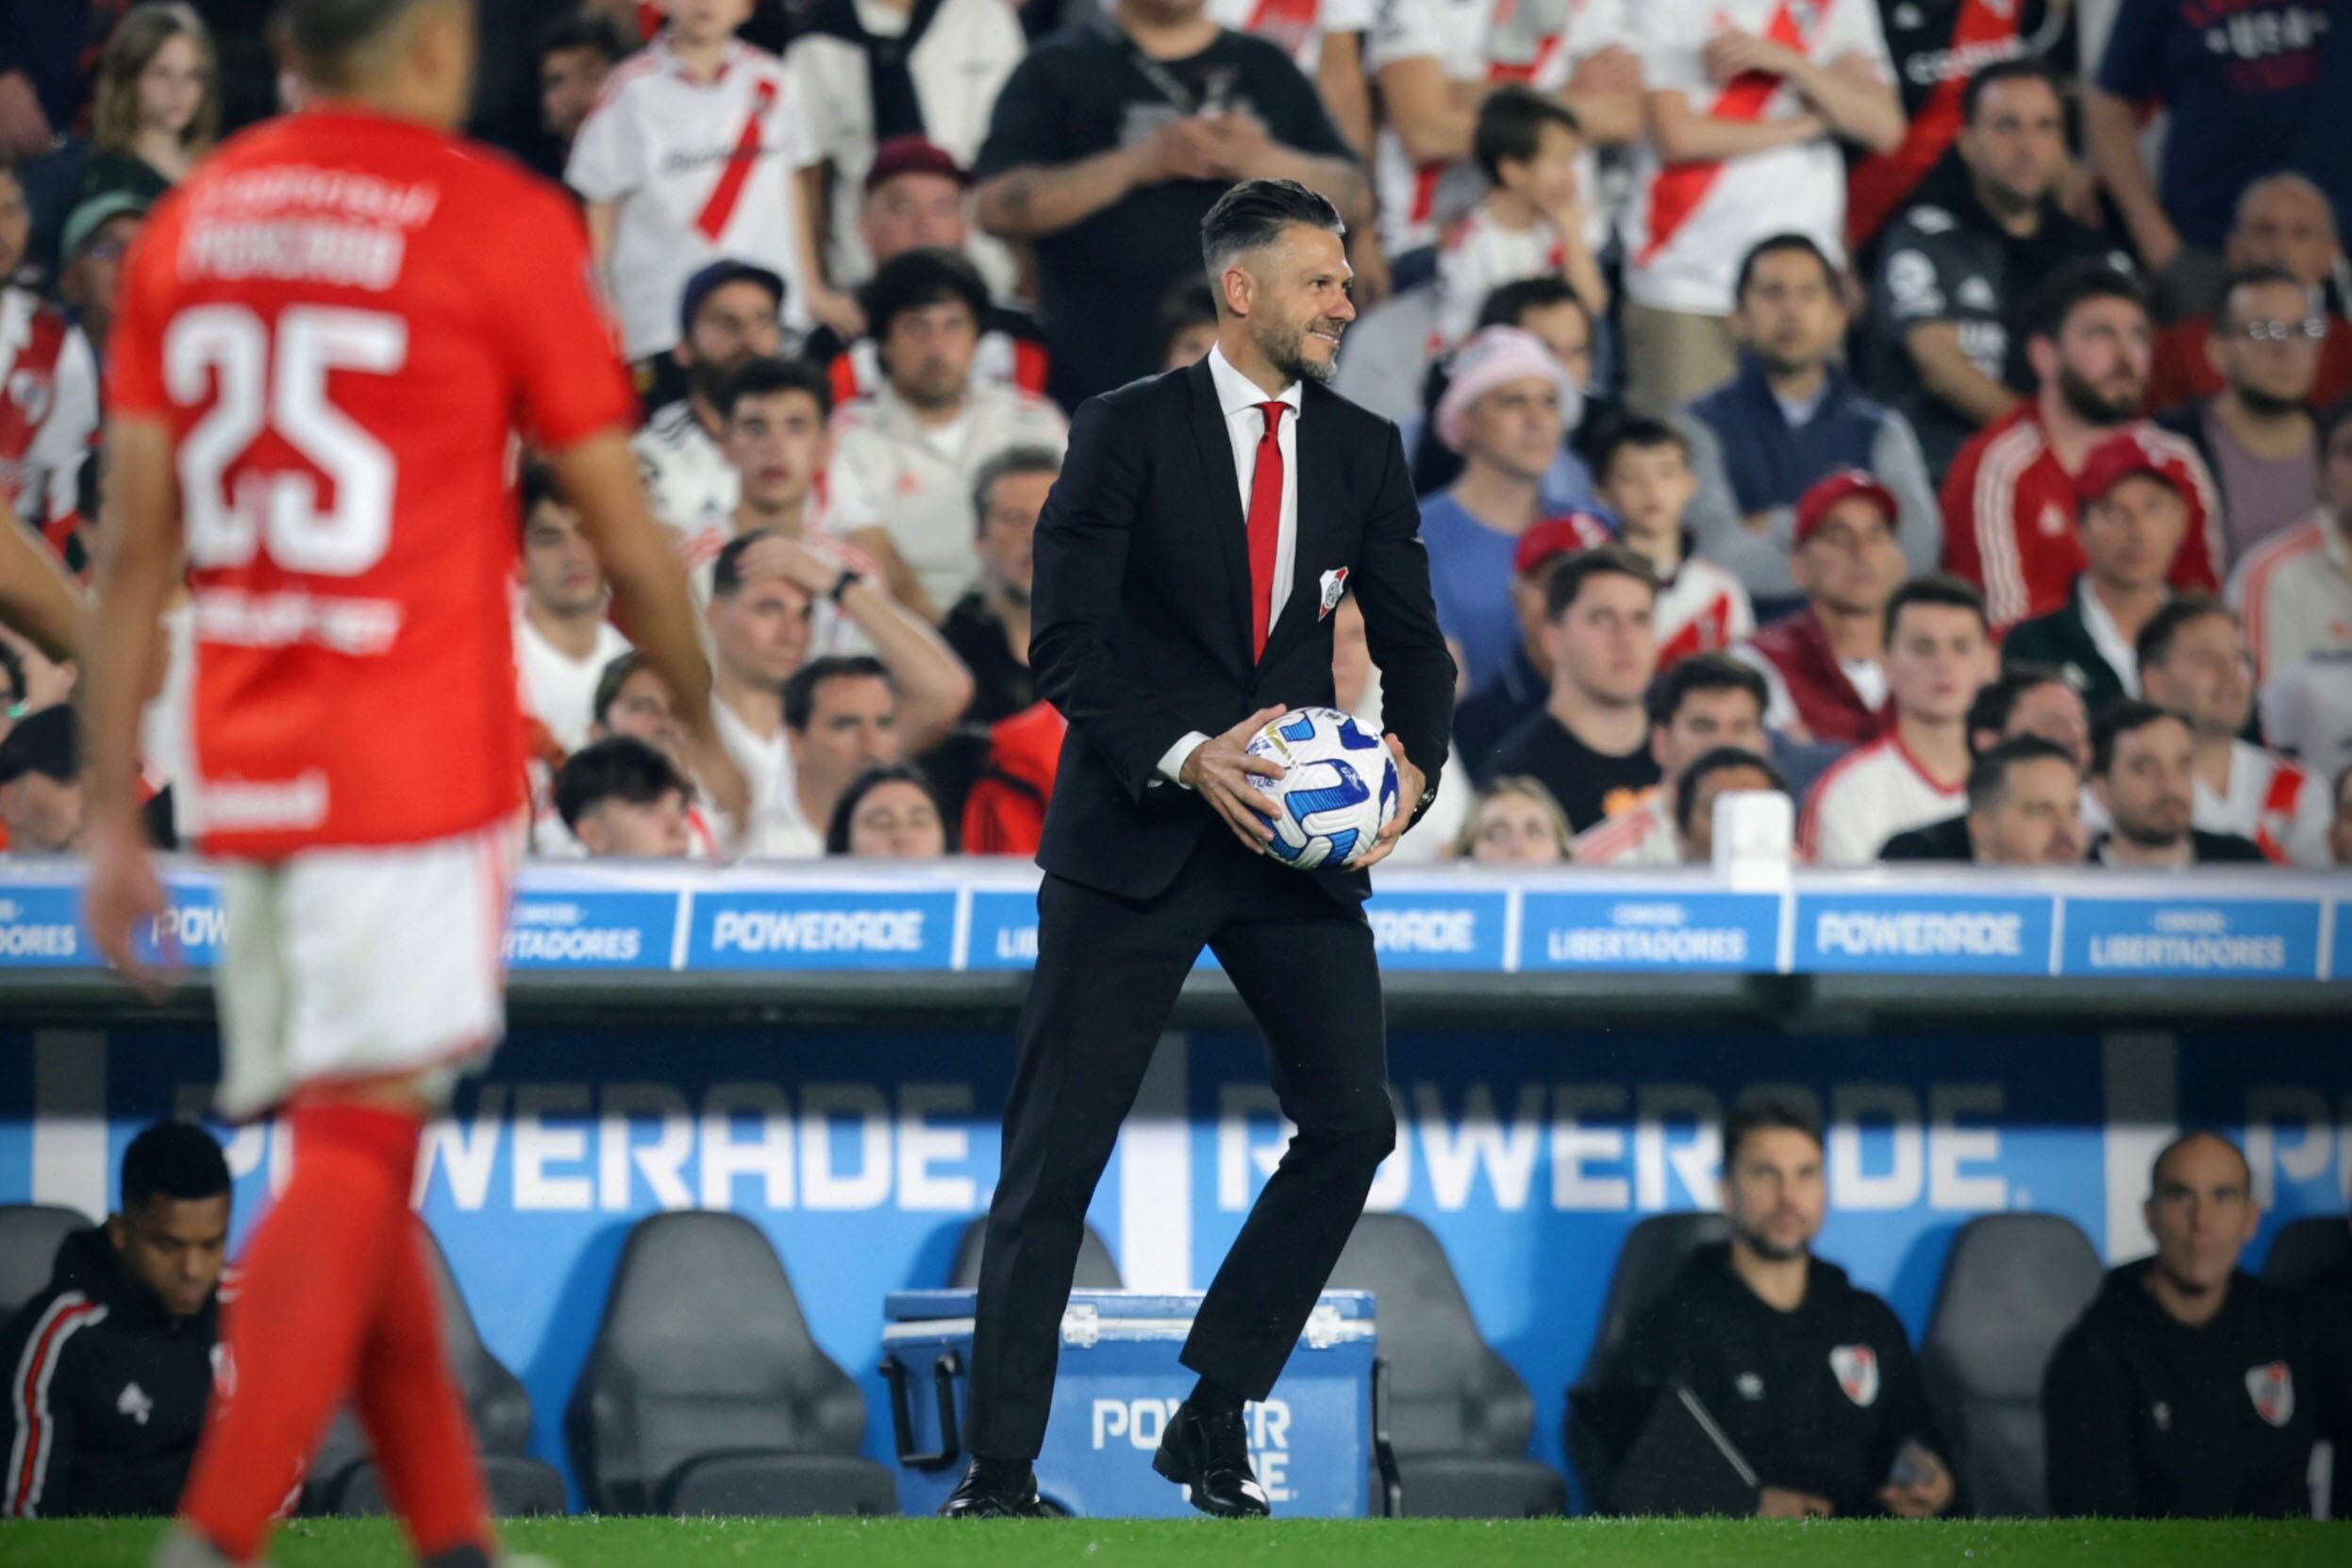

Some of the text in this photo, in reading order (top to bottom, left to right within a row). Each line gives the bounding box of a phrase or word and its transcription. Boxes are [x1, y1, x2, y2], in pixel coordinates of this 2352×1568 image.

[162, 301, 409, 576] 25
[712, 909, 924, 951] POWERADE
[1548, 928, 1747, 962] LIBERTADORES
[1817, 912, 2022, 955] POWERADE
[2089, 935, 2285, 969] LIBERTADORES
